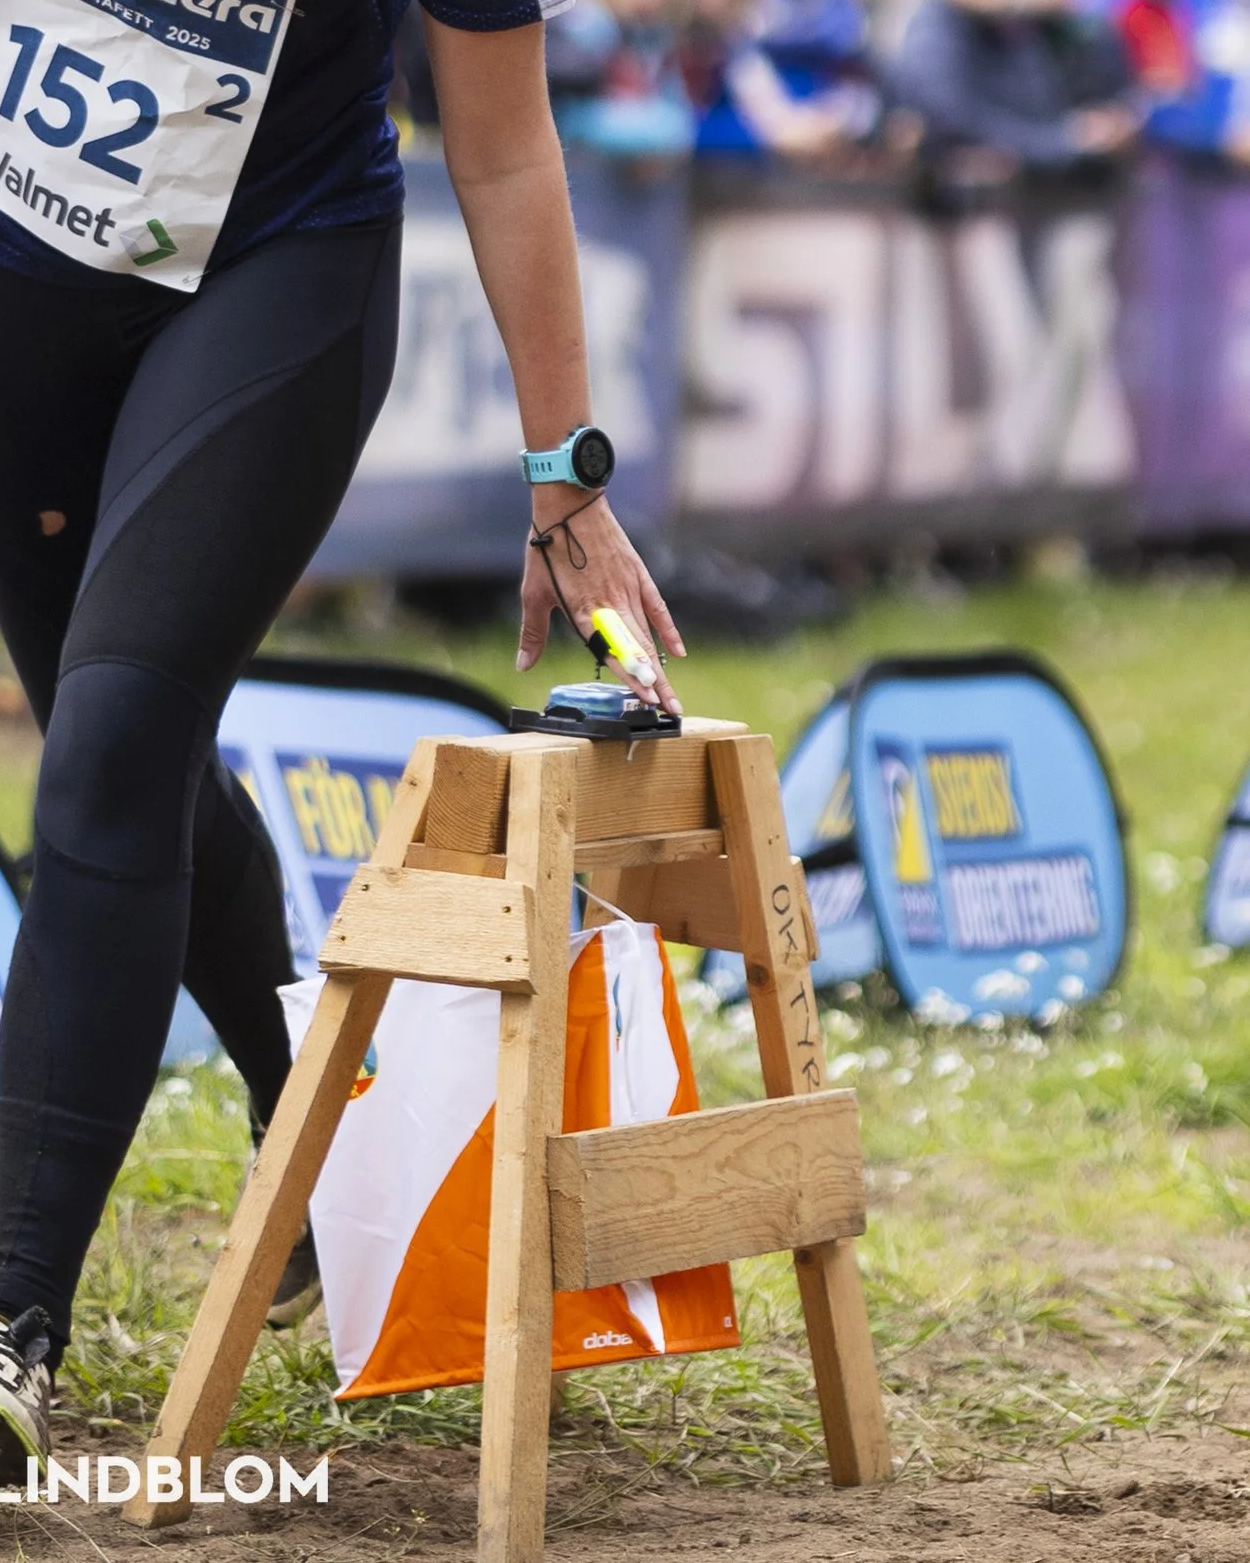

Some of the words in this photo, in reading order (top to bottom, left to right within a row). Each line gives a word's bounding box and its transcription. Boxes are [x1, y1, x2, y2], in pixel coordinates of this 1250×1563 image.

[165, 26, 211, 50] 2025
[204, 73, 251, 124] 2
[771, 884, 798, 964] OK
